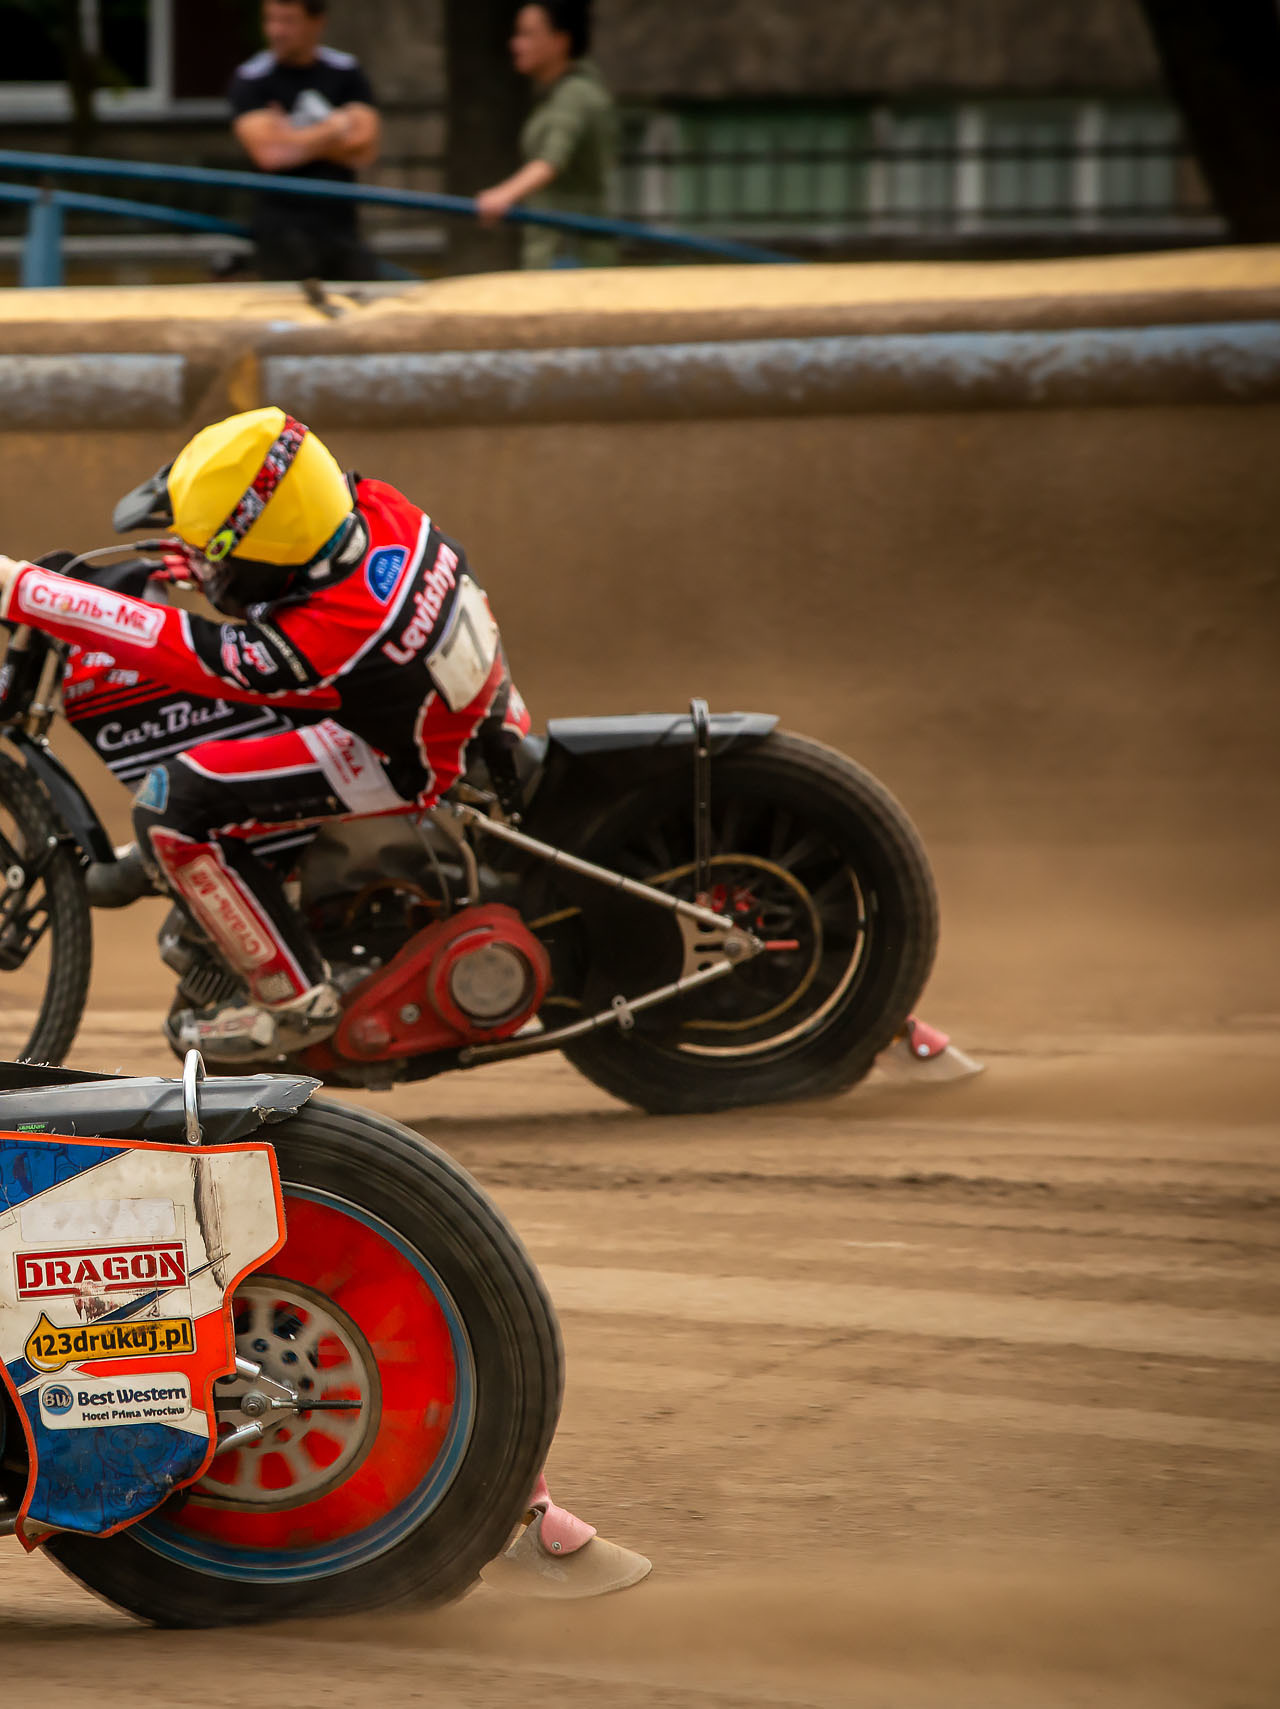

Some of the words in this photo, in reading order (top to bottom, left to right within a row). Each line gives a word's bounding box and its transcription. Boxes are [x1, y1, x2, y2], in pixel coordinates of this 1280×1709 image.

[17, 1251, 186, 1289] DRAGON
[32, 1324, 189, 1356] 123drukuj.pl
[78, 1391, 115, 1406] Best
[116, 1388, 187, 1404] Western
[82, 1411, 109, 1421] Hotel
[112, 1409, 141, 1419] Prima
